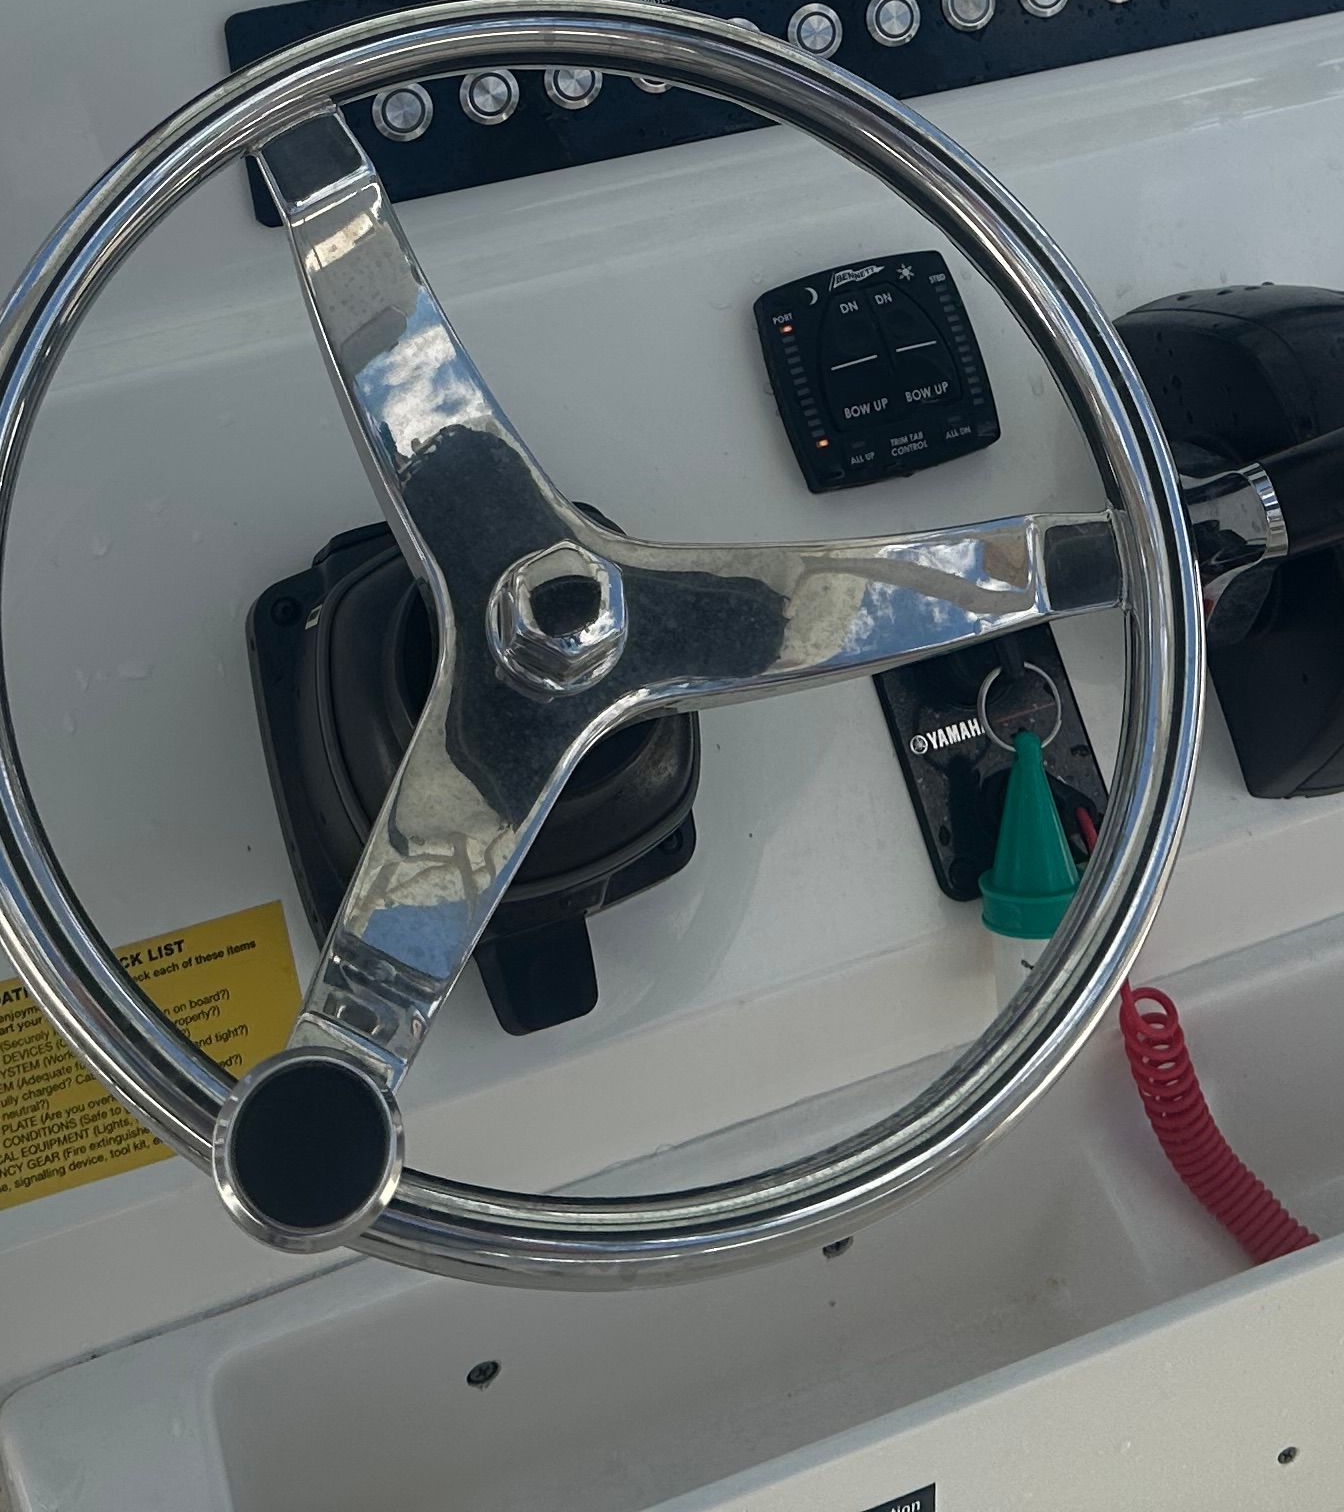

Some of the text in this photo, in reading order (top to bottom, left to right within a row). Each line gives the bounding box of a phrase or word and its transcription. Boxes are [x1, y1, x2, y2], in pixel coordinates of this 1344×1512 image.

[835, 266, 876, 284] BENNETT
[839, 300, 859, 314] DN
[874, 292, 894, 306] DN
[772, 312, 793, 326] PORT
[904, 381, 949, 403] BOW UP
[843, 397, 889, 420] BOW UP
[890, 435, 909, 447] TRIM
[945, 429, 959, 440] ALL
[849, 454, 865, 465] ALL
[891, 440, 929, 457] CONTROL
[147, 939, 185, 962] LIST
[153, 962, 180, 978] each
[181, 957, 193, 969] of
[194, 950, 225, 965] these
[226, 940, 257, 957] items
[2, 1041, 54, 1065] DEVICES
[172, 1003, 187, 1014] on
[189, 988, 230, 1007] board?)
[18, 1016, 43, 1032] your
[0, 1030, 50, 1053] (Securely
[43, 1050, 75, 1069] (Work
[174, 1005, 221, 1026] roperly?)
[21, 1077, 73, 1101] charged?
[214, 1024, 249, 1043] tight?)
[16, 1065, 73, 1090] (Adequate
[1, 1098, 50, 1121] neutral?)
[1, 1115, 39, 1136] PLATE
[40, 1109, 62, 1124] (Are
[65, 1103, 86, 1118] you
[2, 1118, 78, 1149] CONDITIONS
[79, 1110, 108, 1127] (Safe
[109, 1106, 122, 1117] to
[20, 1128, 90, 1158] EQUIPMENT
[26, 1151, 61, 1170] GEAR
[62, 1145, 87, 1161] (Fire
[89, 1126, 151, 1151] extinguishe
[14, 1165, 67, 1188] signalling
[68, 1155, 108, 1172] device,
[109, 1145, 131, 1159] tool
[134, 1139, 151, 1152] kit,
